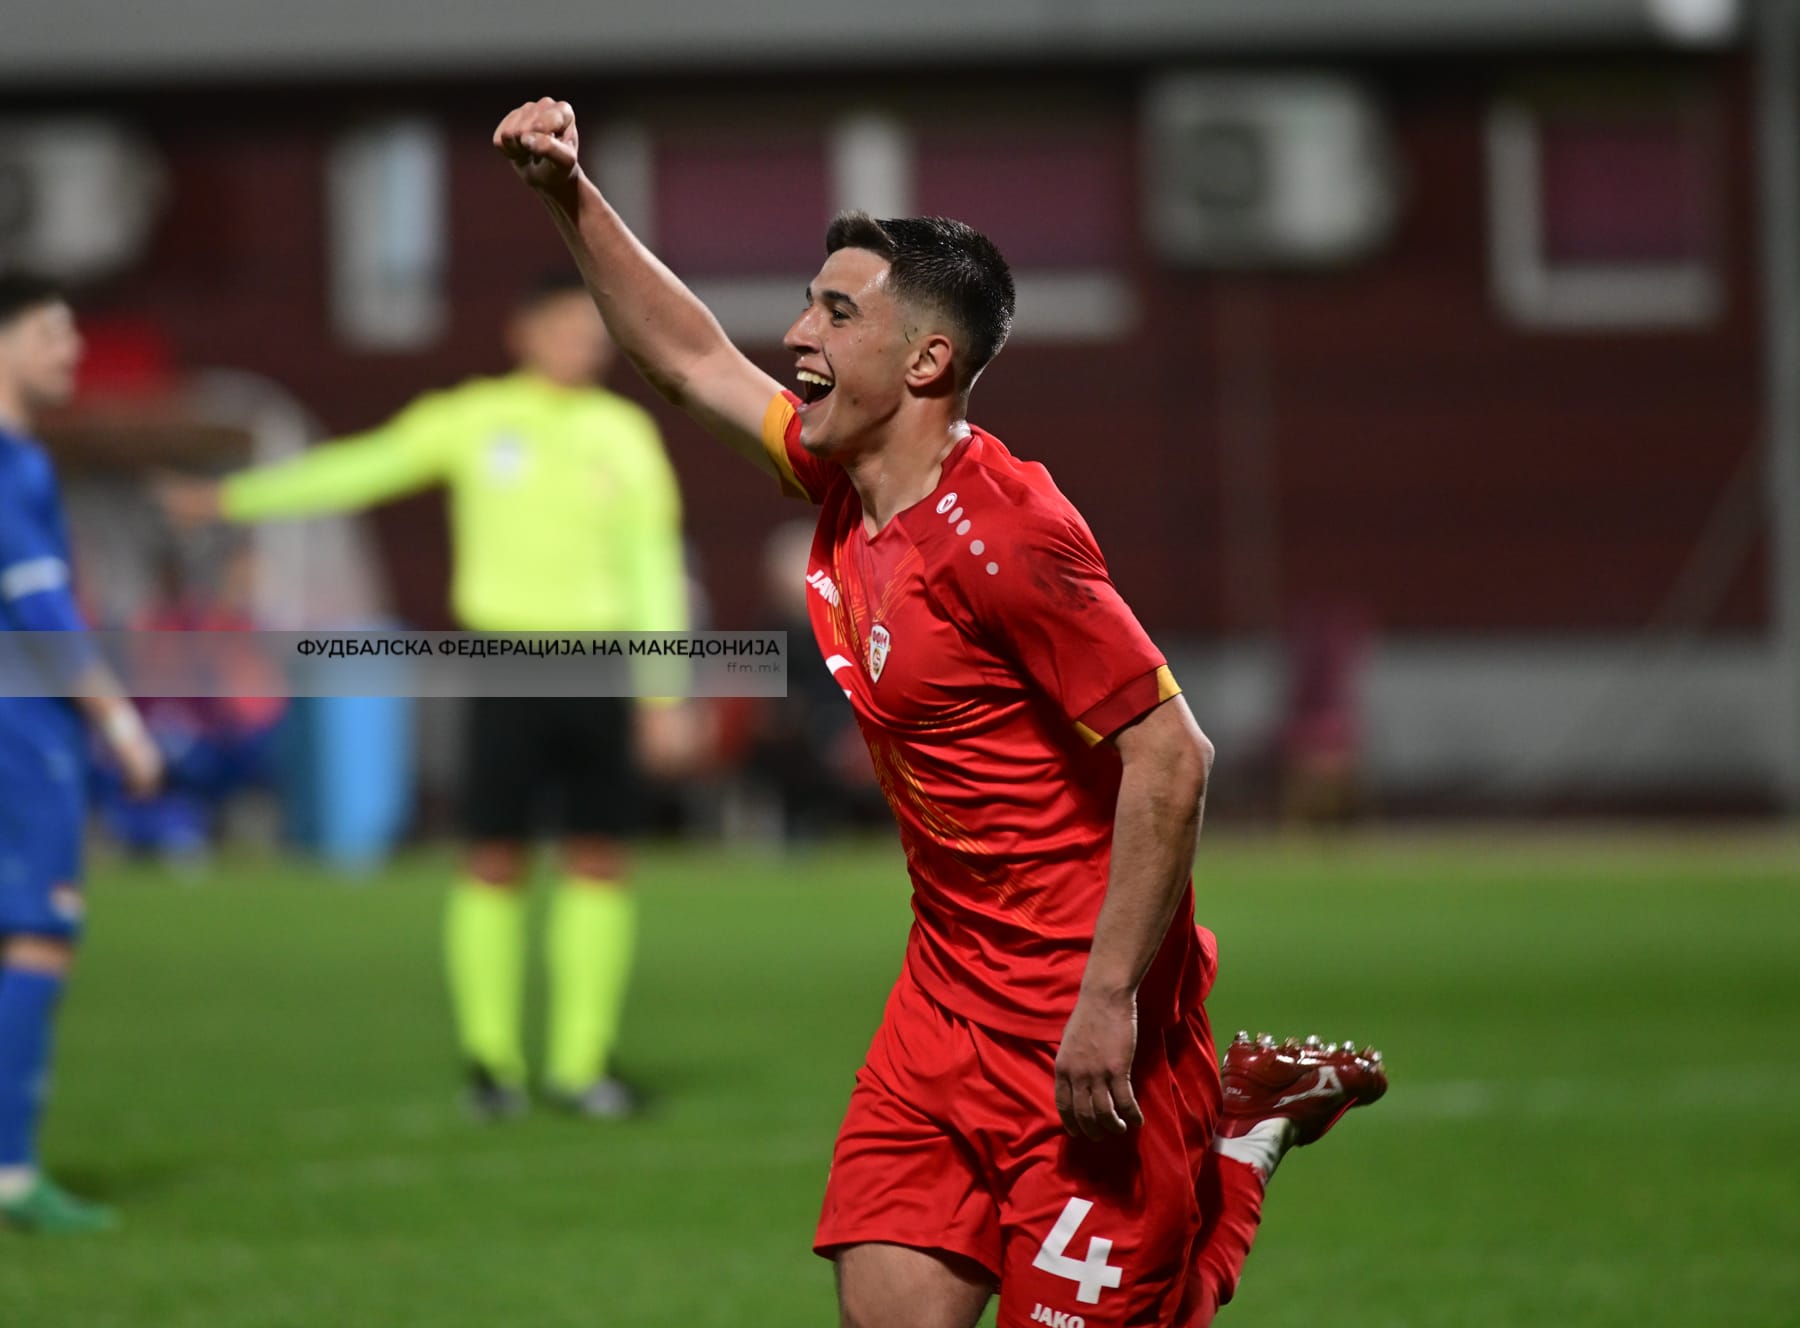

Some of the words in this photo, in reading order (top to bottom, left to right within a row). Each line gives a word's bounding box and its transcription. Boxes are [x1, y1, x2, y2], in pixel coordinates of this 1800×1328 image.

[807, 569, 840, 608] JAKO
[1032, 1196, 1123, 1304] 4
[1030, 1303, 1085, 1328] JAKO
